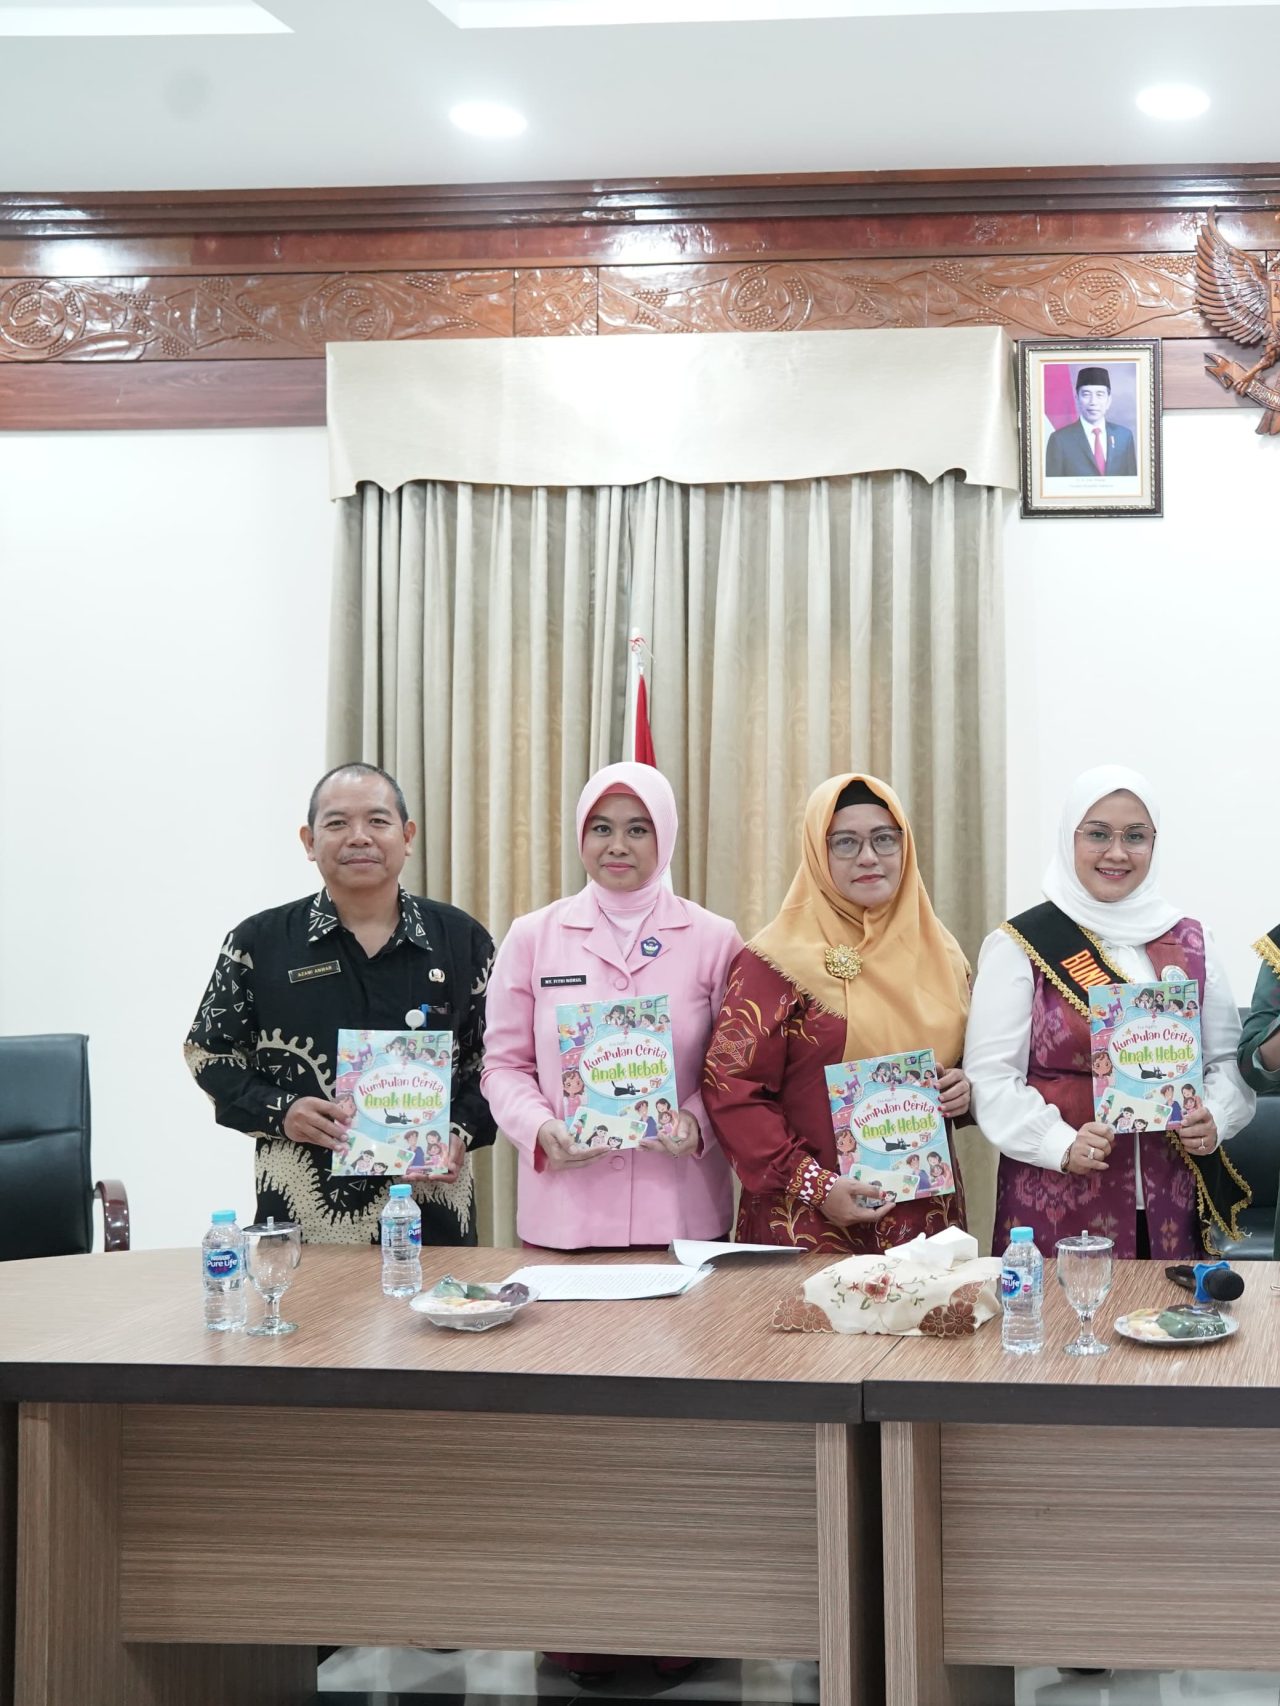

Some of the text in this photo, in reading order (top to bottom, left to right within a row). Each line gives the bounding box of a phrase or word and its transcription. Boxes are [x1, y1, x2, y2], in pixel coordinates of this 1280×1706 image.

[1061, 949, 1111, 992] BUND
[1163, 1028, 1194, 1045] Cerita
[635, 1044, 667, 1059] Cerita
[1119, 1044, 1195, 1065] Anak Hebat
[591, 1059, 669, 1082] Anak Hebat
[412, 1076, 444, 1093] Cerita
[364, 1091, 444, 1110] Anak Hebat
[903, 1099, 935, 1113] Cerita
[862, 1113, 937, 1140] Anak Hebat
[207, 1259, 238, 1268] Pure Life
